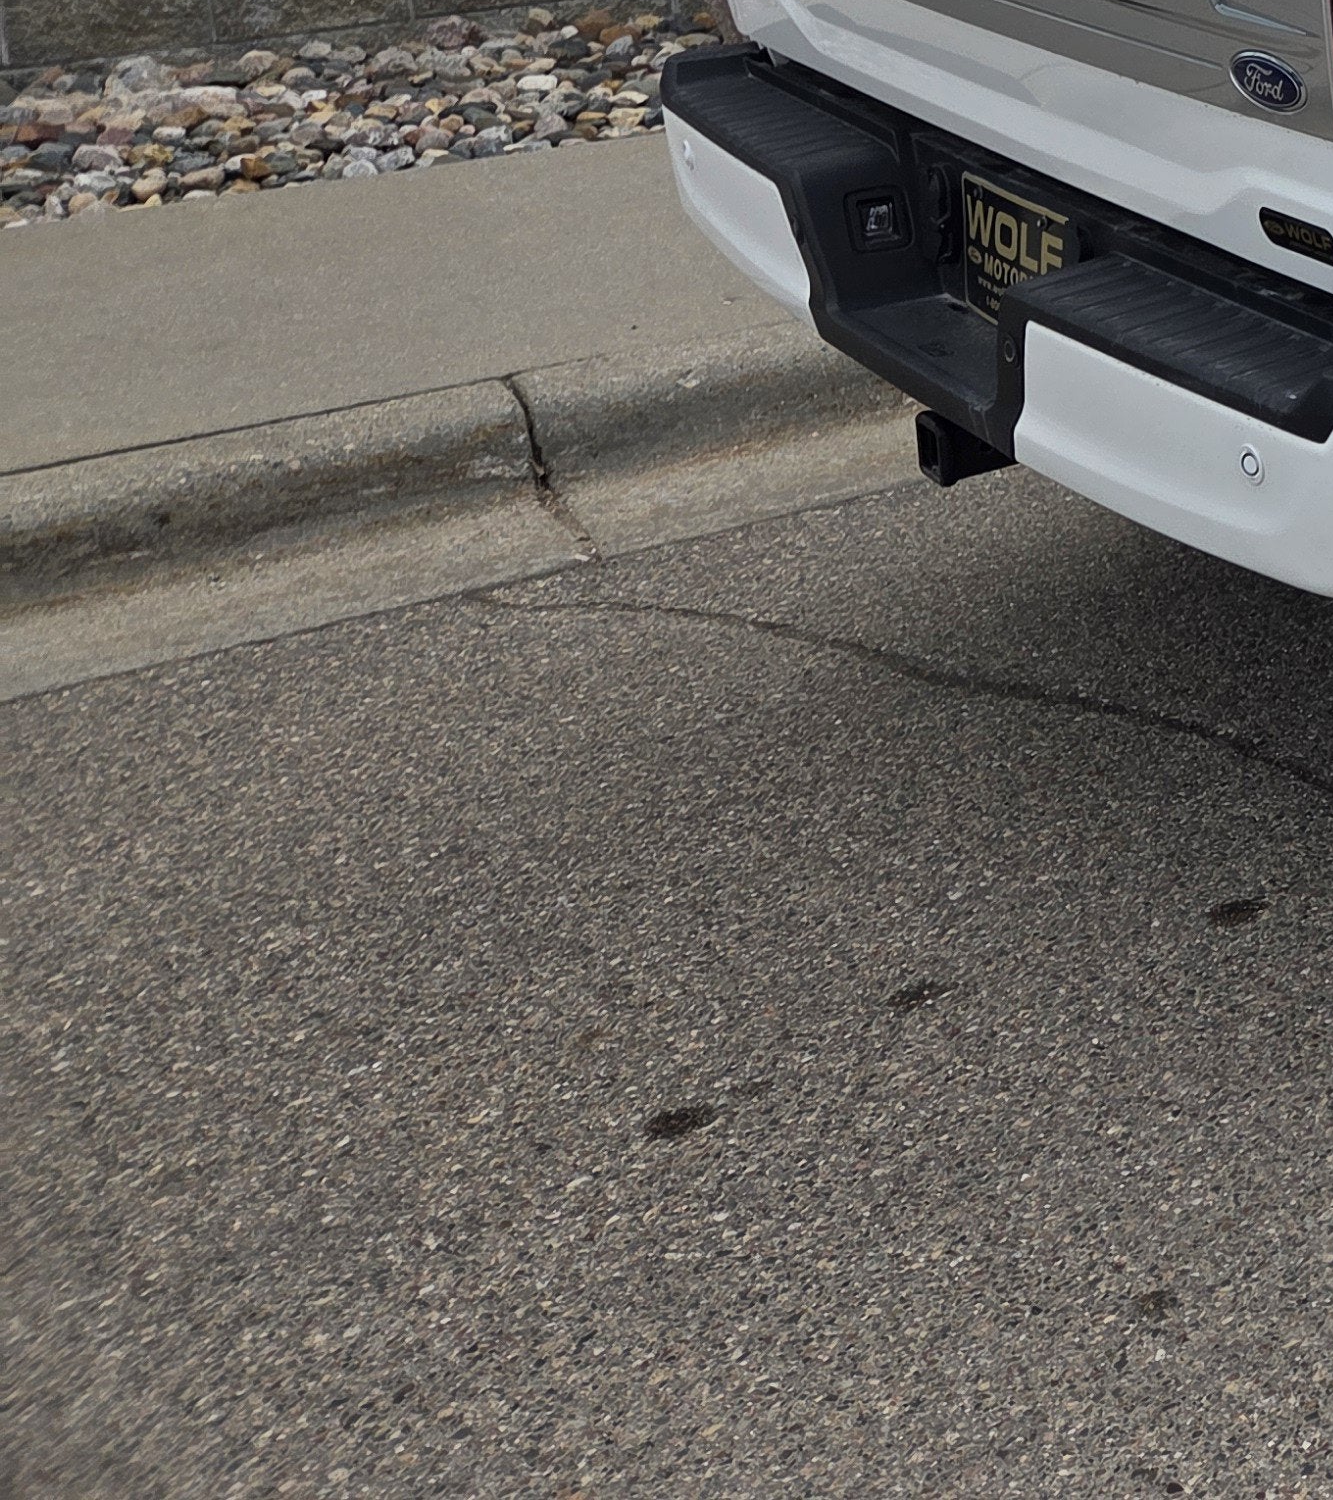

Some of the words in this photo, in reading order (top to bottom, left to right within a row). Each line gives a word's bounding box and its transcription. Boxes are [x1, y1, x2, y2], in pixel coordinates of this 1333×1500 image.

[1244, 63, 1284, 101] Ford
[966, 194, 1064, 275] WOLF
[1284, 221, 1331, 250] WOLF
